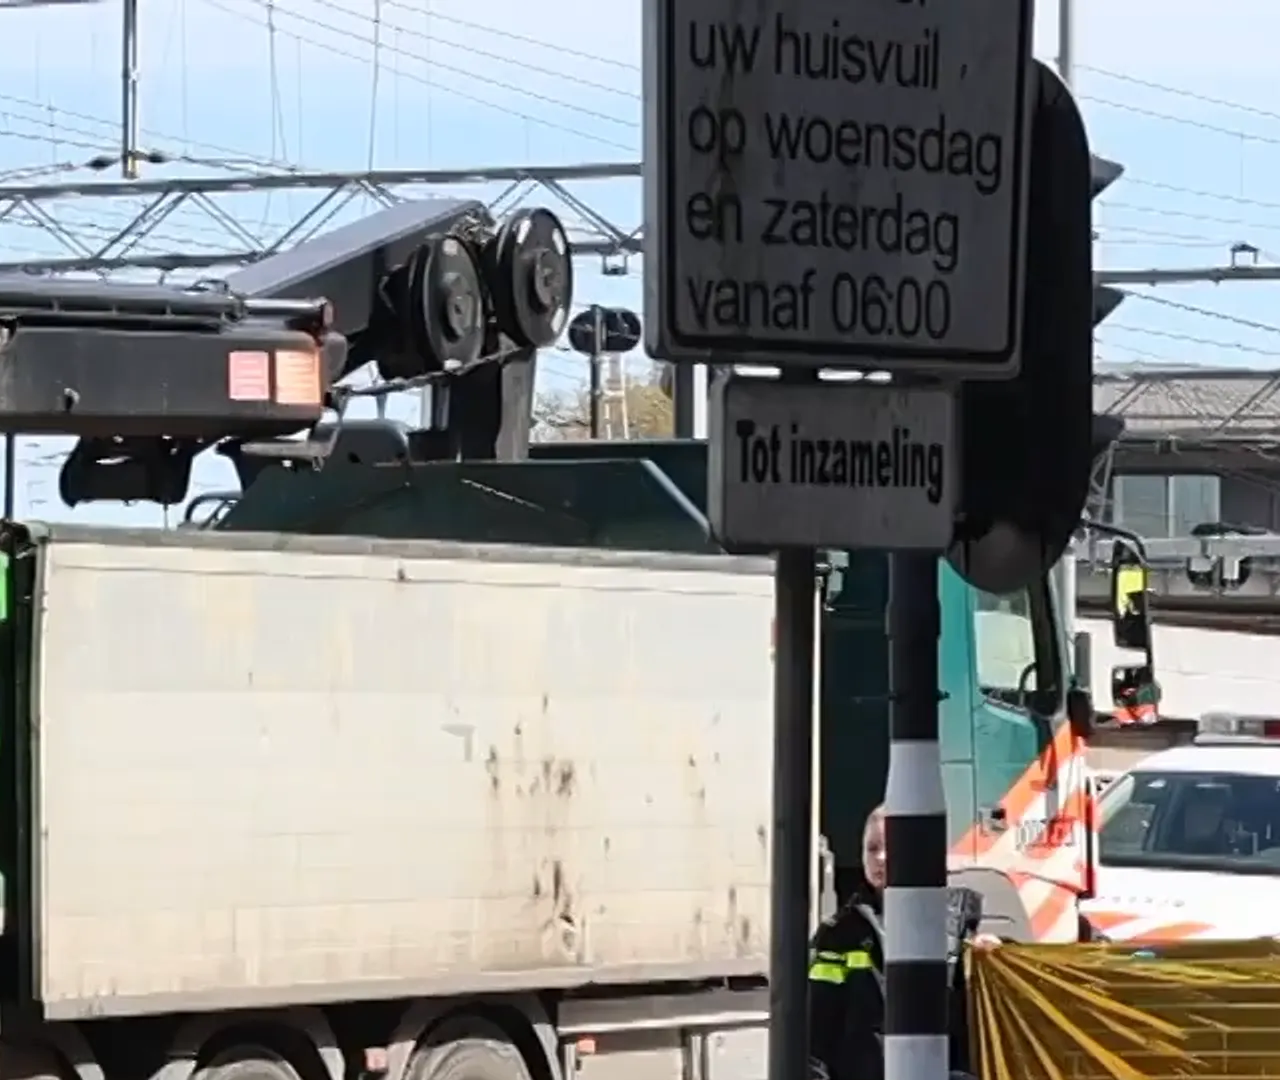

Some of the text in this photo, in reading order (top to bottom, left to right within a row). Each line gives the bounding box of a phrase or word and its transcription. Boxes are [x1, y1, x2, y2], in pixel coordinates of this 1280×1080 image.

[689, 12, 940, 90] uw huisvuil
[688, 106, 1003, 195] op woensdag
[686, 191, 959, 273] en zaterdag
[687, 268, 951, 339] vanaf 06:00
[736, 419, 944, 504] Tot inzameling
